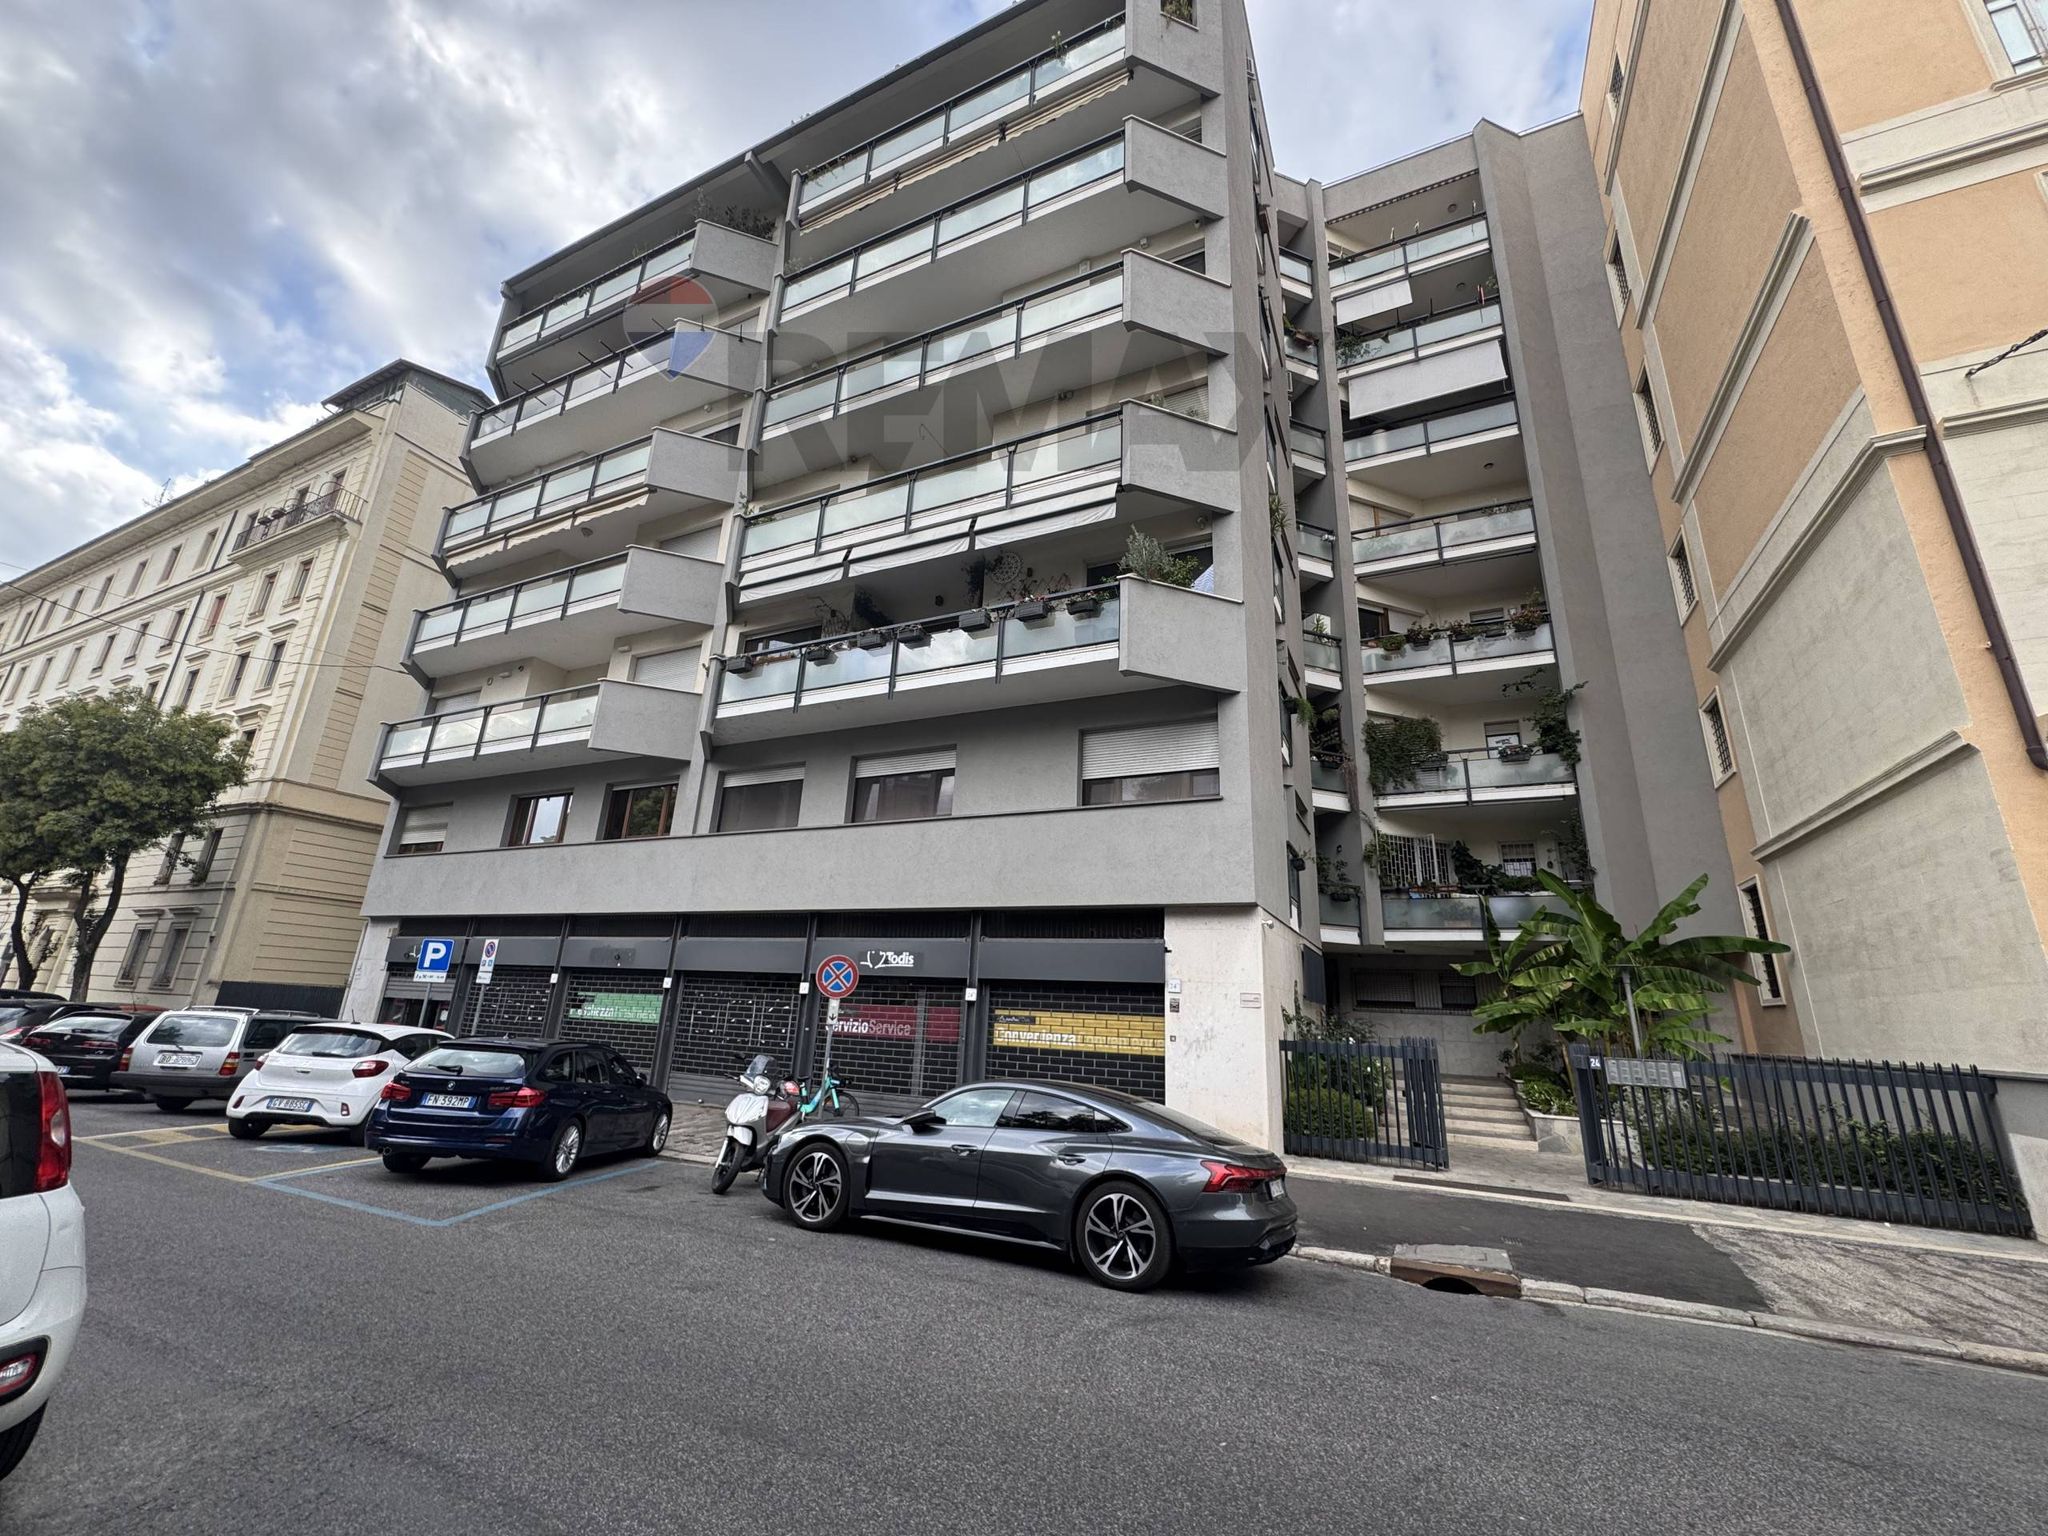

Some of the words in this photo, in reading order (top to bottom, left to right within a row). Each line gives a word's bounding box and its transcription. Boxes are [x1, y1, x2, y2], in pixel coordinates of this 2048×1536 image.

[423, 942, 447, 968] P
[885, 951, 915, 965] Todis
[1590, 1058, 1600, 1067] 24
